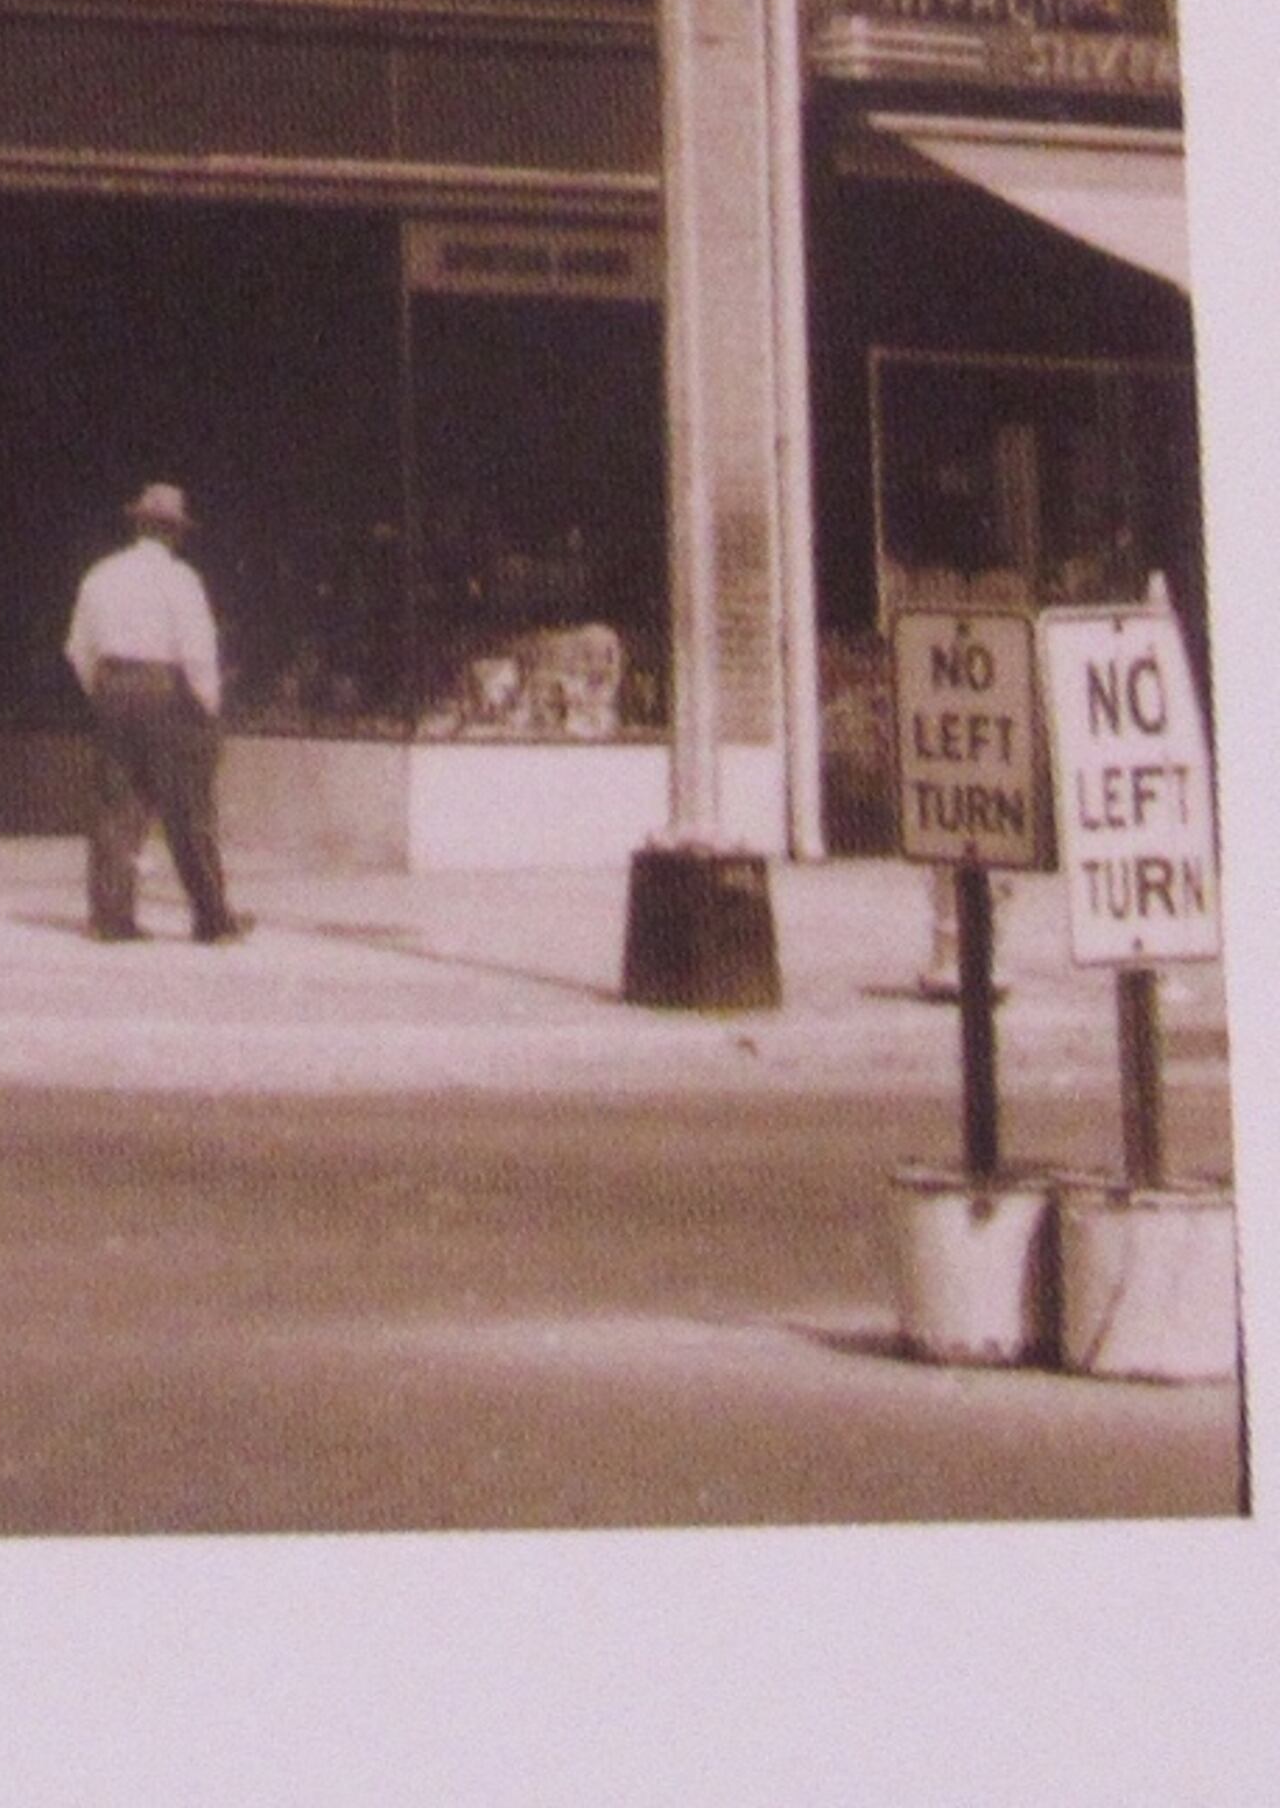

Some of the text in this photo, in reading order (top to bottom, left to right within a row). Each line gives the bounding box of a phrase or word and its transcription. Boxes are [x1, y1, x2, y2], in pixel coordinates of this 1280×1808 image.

[930, 643, 993, 692] NO
[1086, 655, 1168, 736] NO
[913, 713, 1013, 765] LEFT
[913, 780, 1025, 834] TURN
[1076, 764, 1189, 831] LEFT
[1081, 856, 1206, 920] TURN
